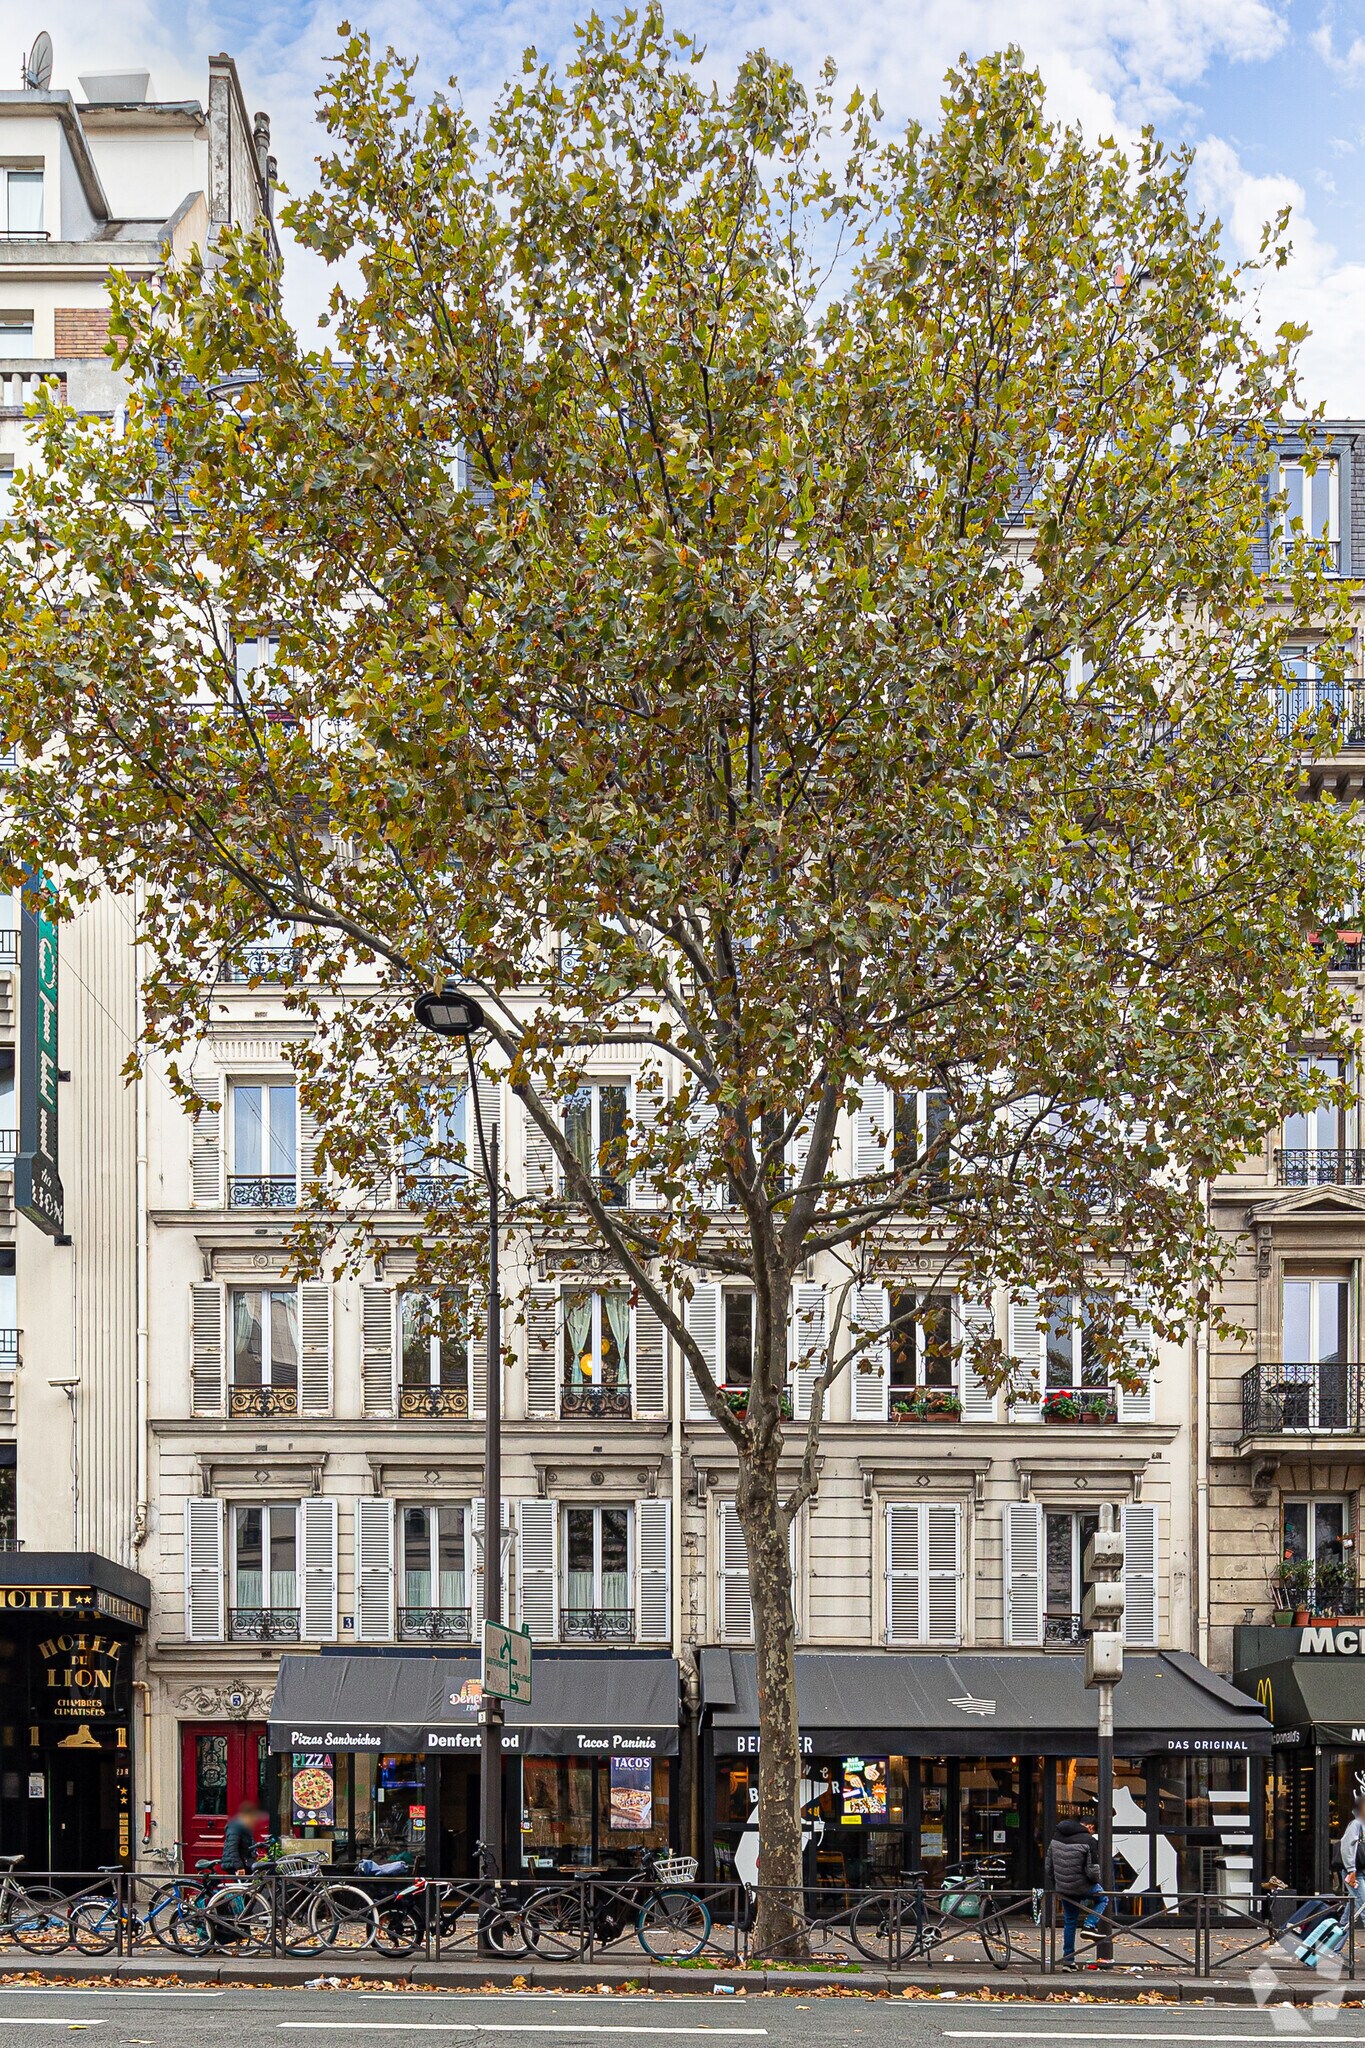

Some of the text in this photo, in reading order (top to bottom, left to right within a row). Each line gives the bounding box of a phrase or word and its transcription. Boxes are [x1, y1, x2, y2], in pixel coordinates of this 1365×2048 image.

[38, 875, 58, 1163] OTEL
[38, 1634, 122, 1661] HOTEL
[1300, 1627, 1365, 1654] Mc
[71, 1655, 88, 1665] DU
[47, 1669, 111, 1688] LION
[57, 1699, 102, 1707] CHAMBRES
[54, 1708, 105, 1716] CLIMATISÉES
[29, 1726, 40, 1746] 1
[115, 1727, 127, 1748] 1
[291, 1731, 381, 1746] Pizzas Sandwiches
[428, 1733, 482, 1747] Denfert
[577, 1734, 656, 1748] Tacos Paninis
[1168, 1740, 1248, 1750] DAS ORIGINAL
[292, 1753, 333, 1767] PIZZA
[613, 1757, 650, 1768] TACOS
